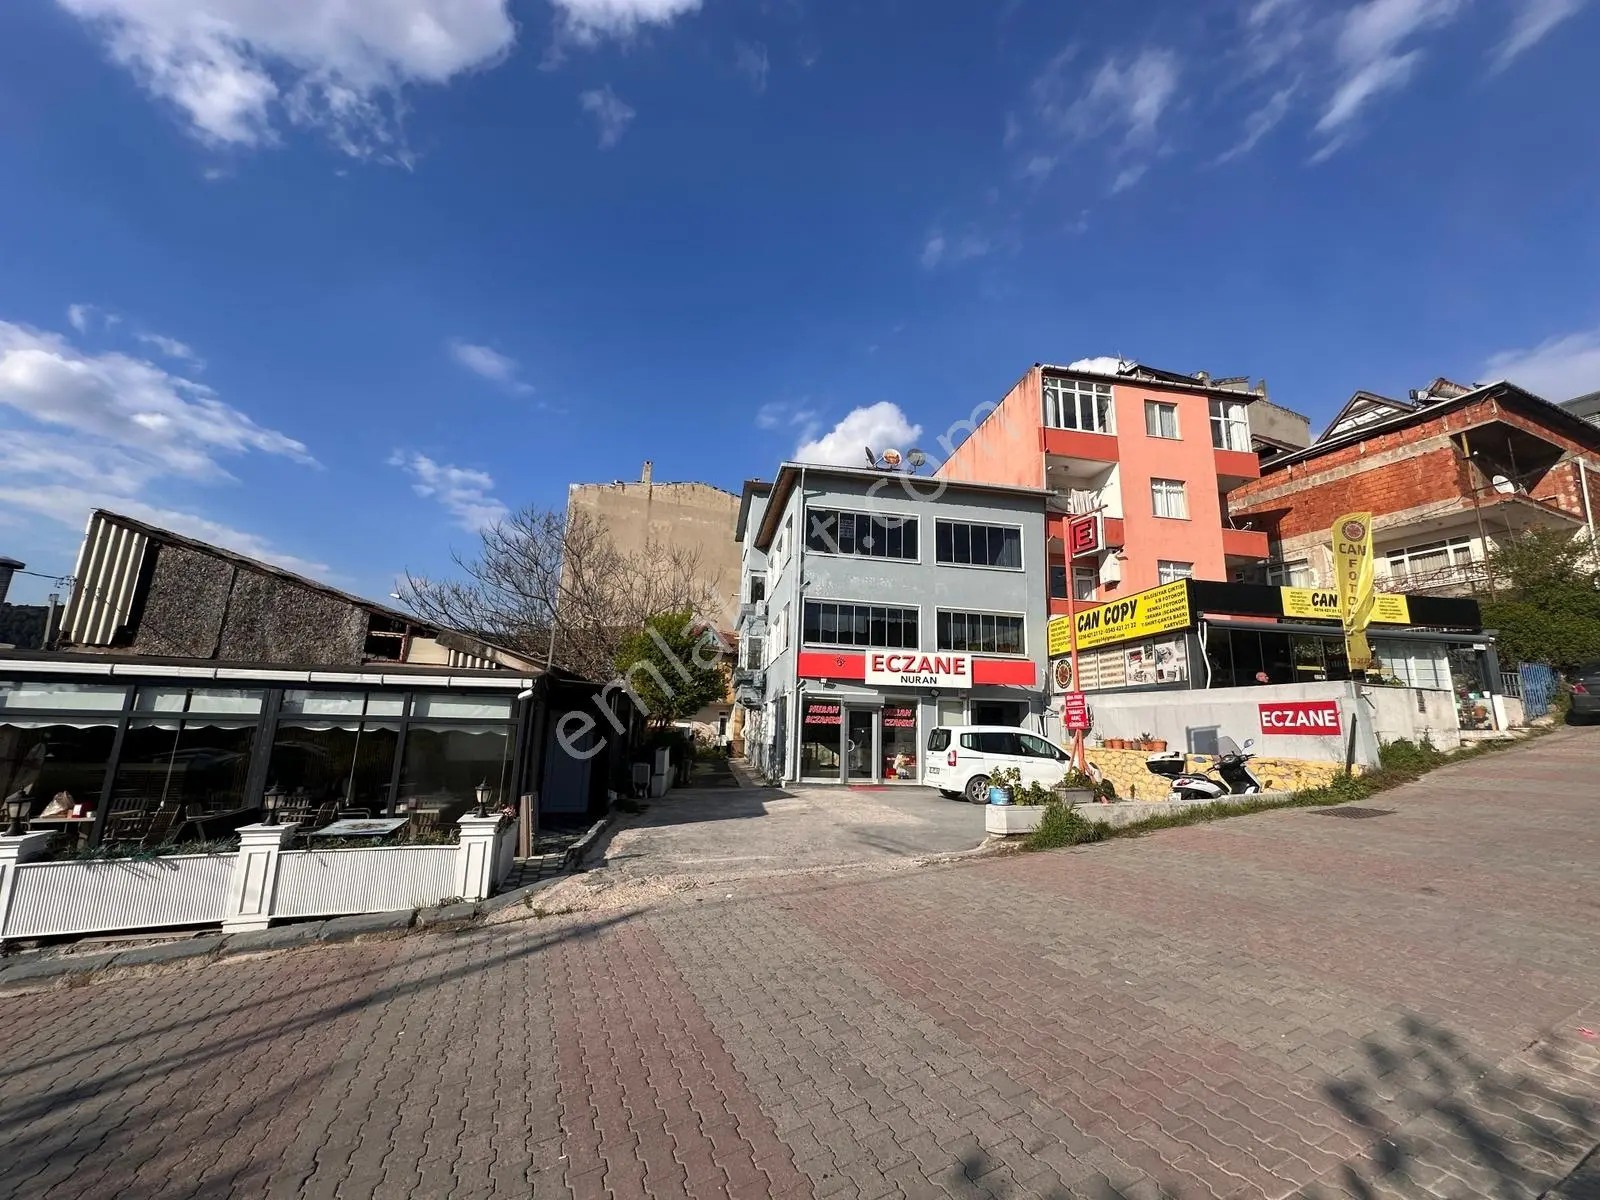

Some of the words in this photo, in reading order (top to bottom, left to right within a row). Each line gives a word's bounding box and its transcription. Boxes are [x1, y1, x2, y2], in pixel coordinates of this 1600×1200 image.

[1339, 543, 1366, 556] CAN
[1312, 592, 1338, 607] CAN
[1078, 610, 1100, 633] CAN
[1104, 599, 1138, 626] COPY
[872, 653, 966, 675] ECZANE
[901, 675, 937, 684] NURAN
[1261, 709, 1337, 727] ECZANE
